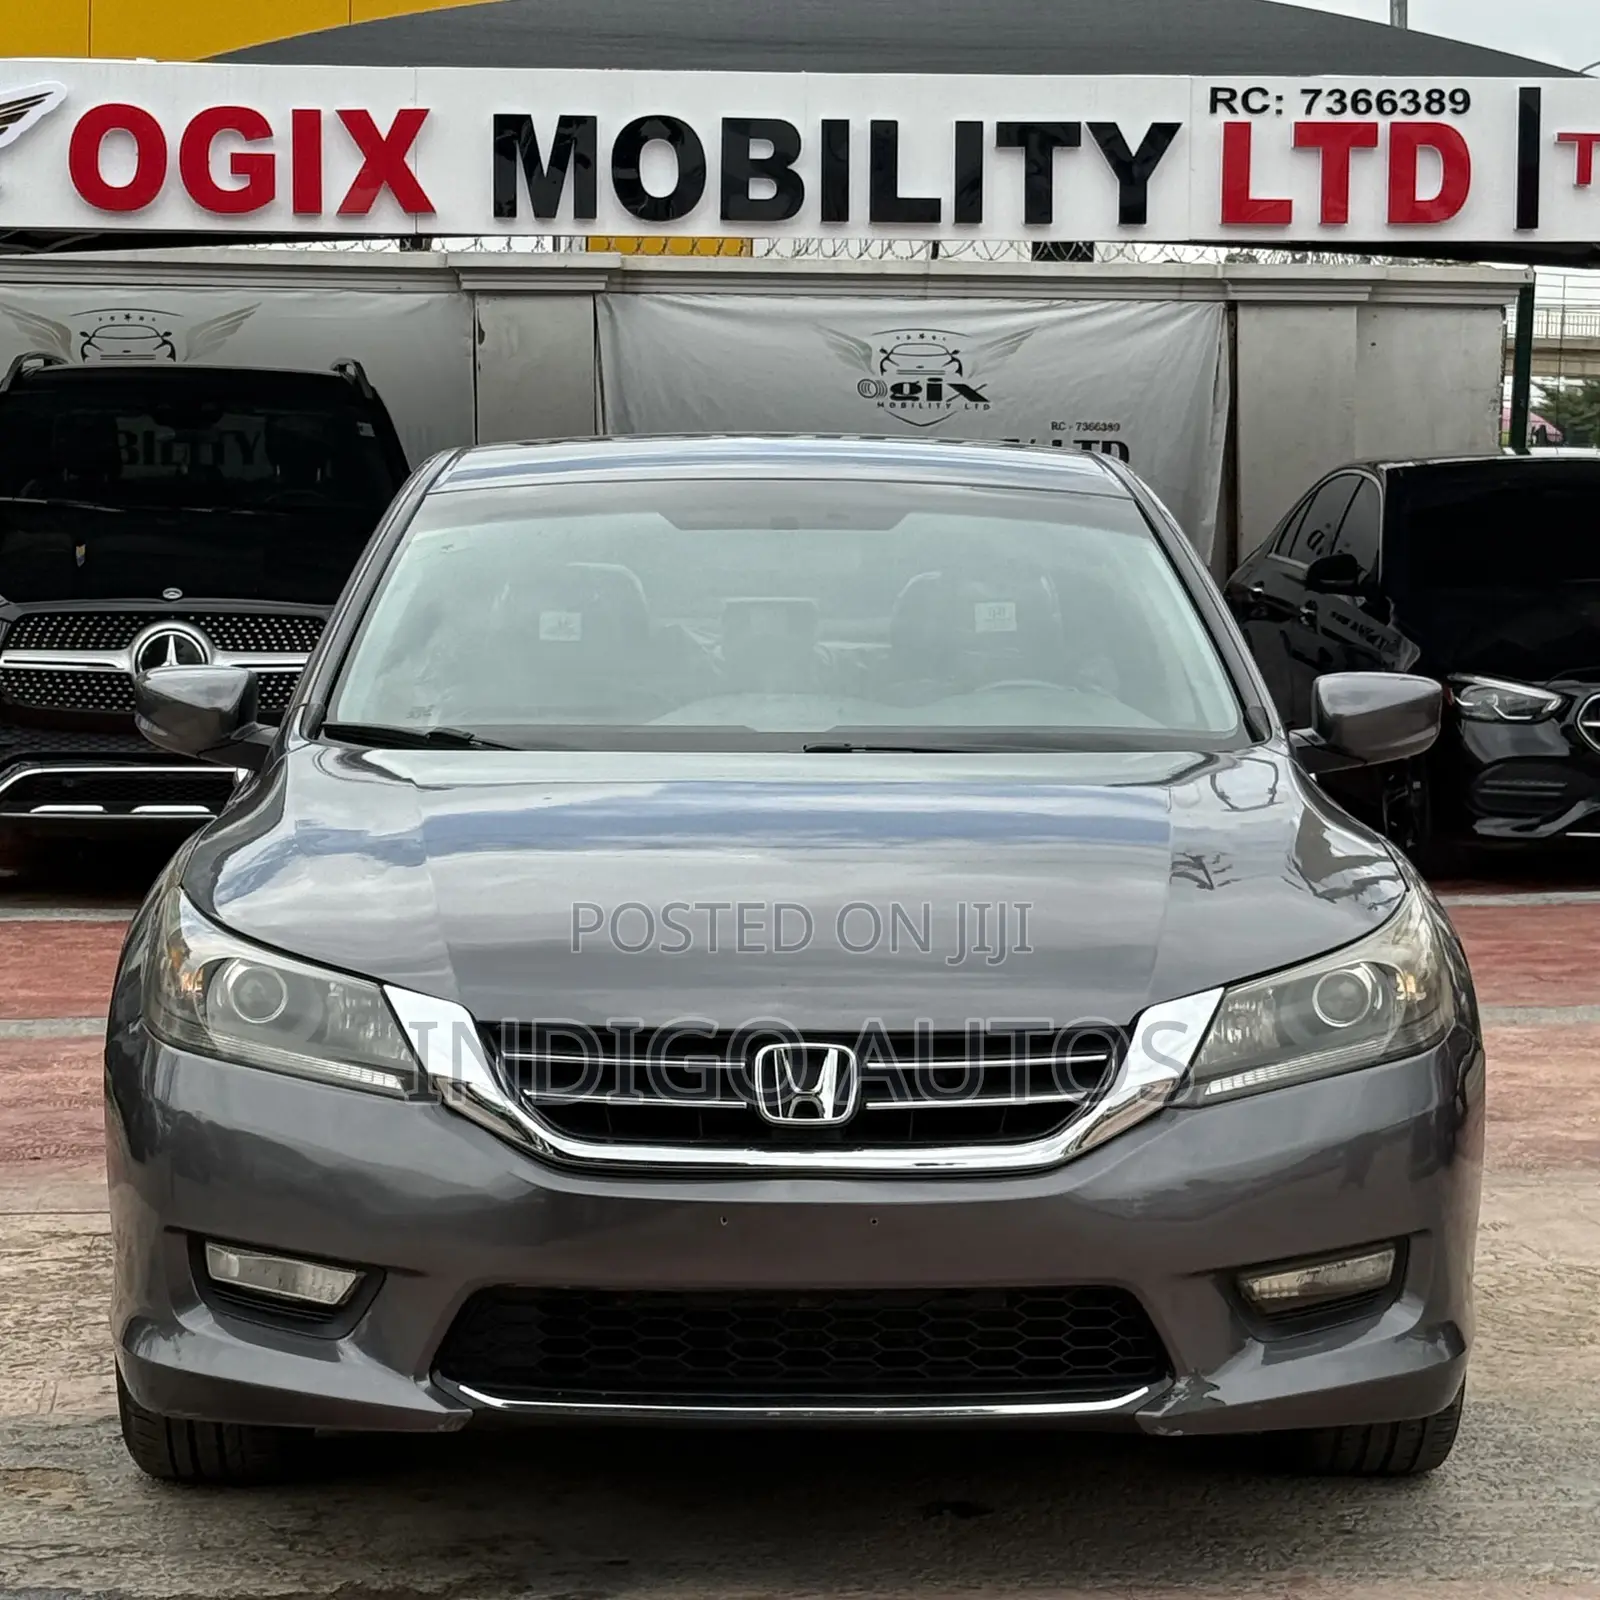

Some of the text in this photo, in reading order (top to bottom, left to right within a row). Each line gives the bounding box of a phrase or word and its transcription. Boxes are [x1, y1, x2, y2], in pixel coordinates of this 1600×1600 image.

[1210, 87, 1471, 115] RC: 7366389
[69, 103, 434, 214] OGIX
[493, 113, 1181, 225] MOBILITY
[1221, 121, 1471, 225] LTD
[876, 401, 991, 411] MOBILITY LTD
[1051, 421, 1066, 431] RC
